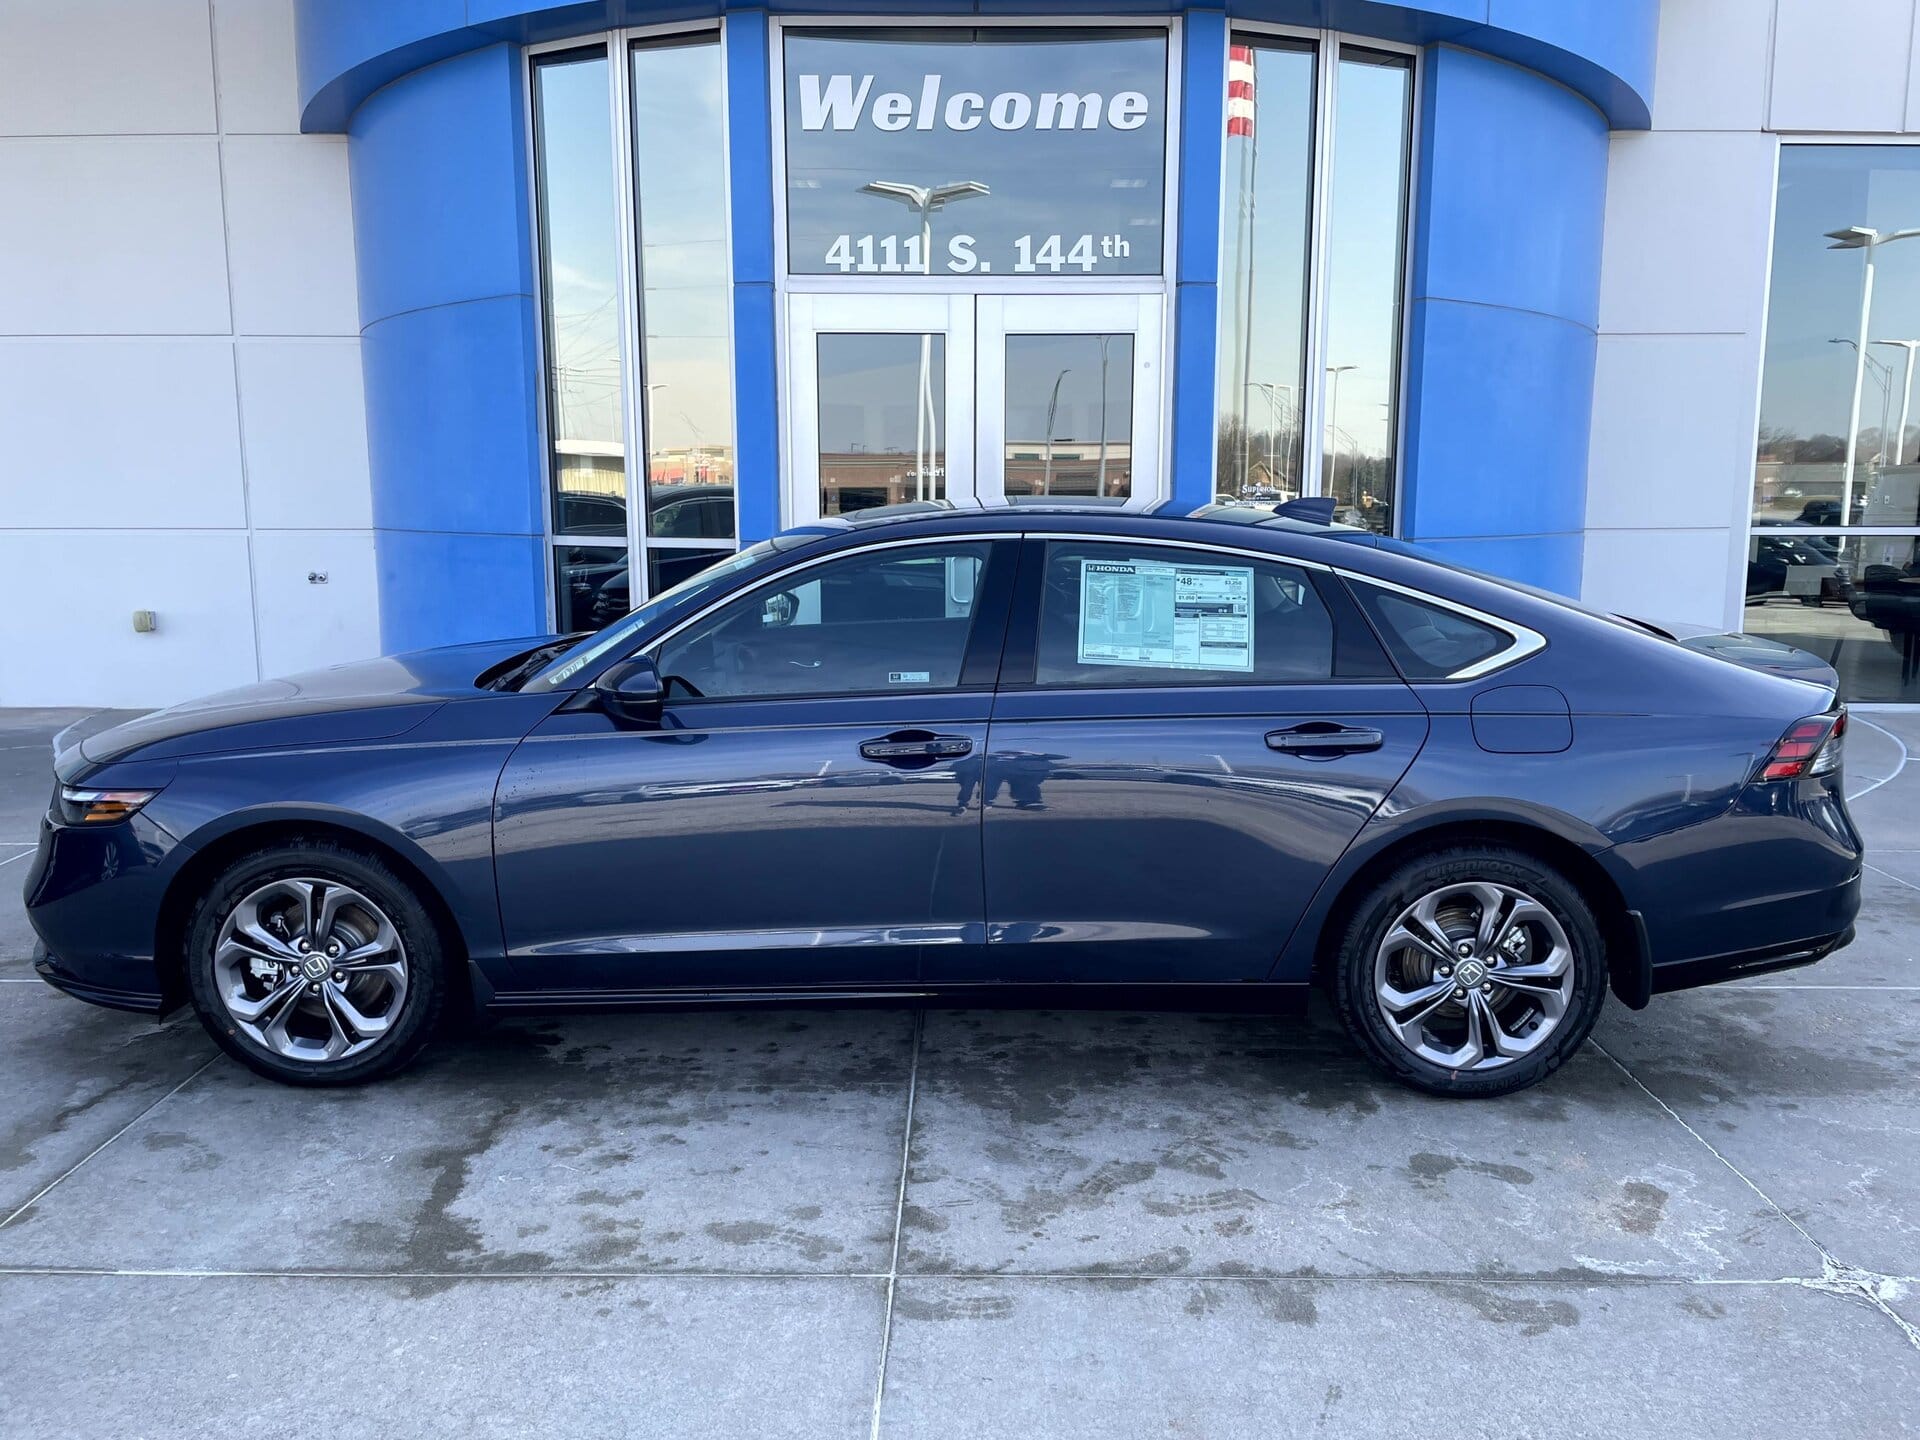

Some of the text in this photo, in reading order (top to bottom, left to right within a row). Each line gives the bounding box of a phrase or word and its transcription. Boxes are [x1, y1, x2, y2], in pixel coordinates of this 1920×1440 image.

[799, 74, 1149, 131] Welcome
[825, 233, 1130, 273] 4111 S. 144th
[1095, 565, 1134, 573] HONDA
[1180, 577, 1192, 586] 48
